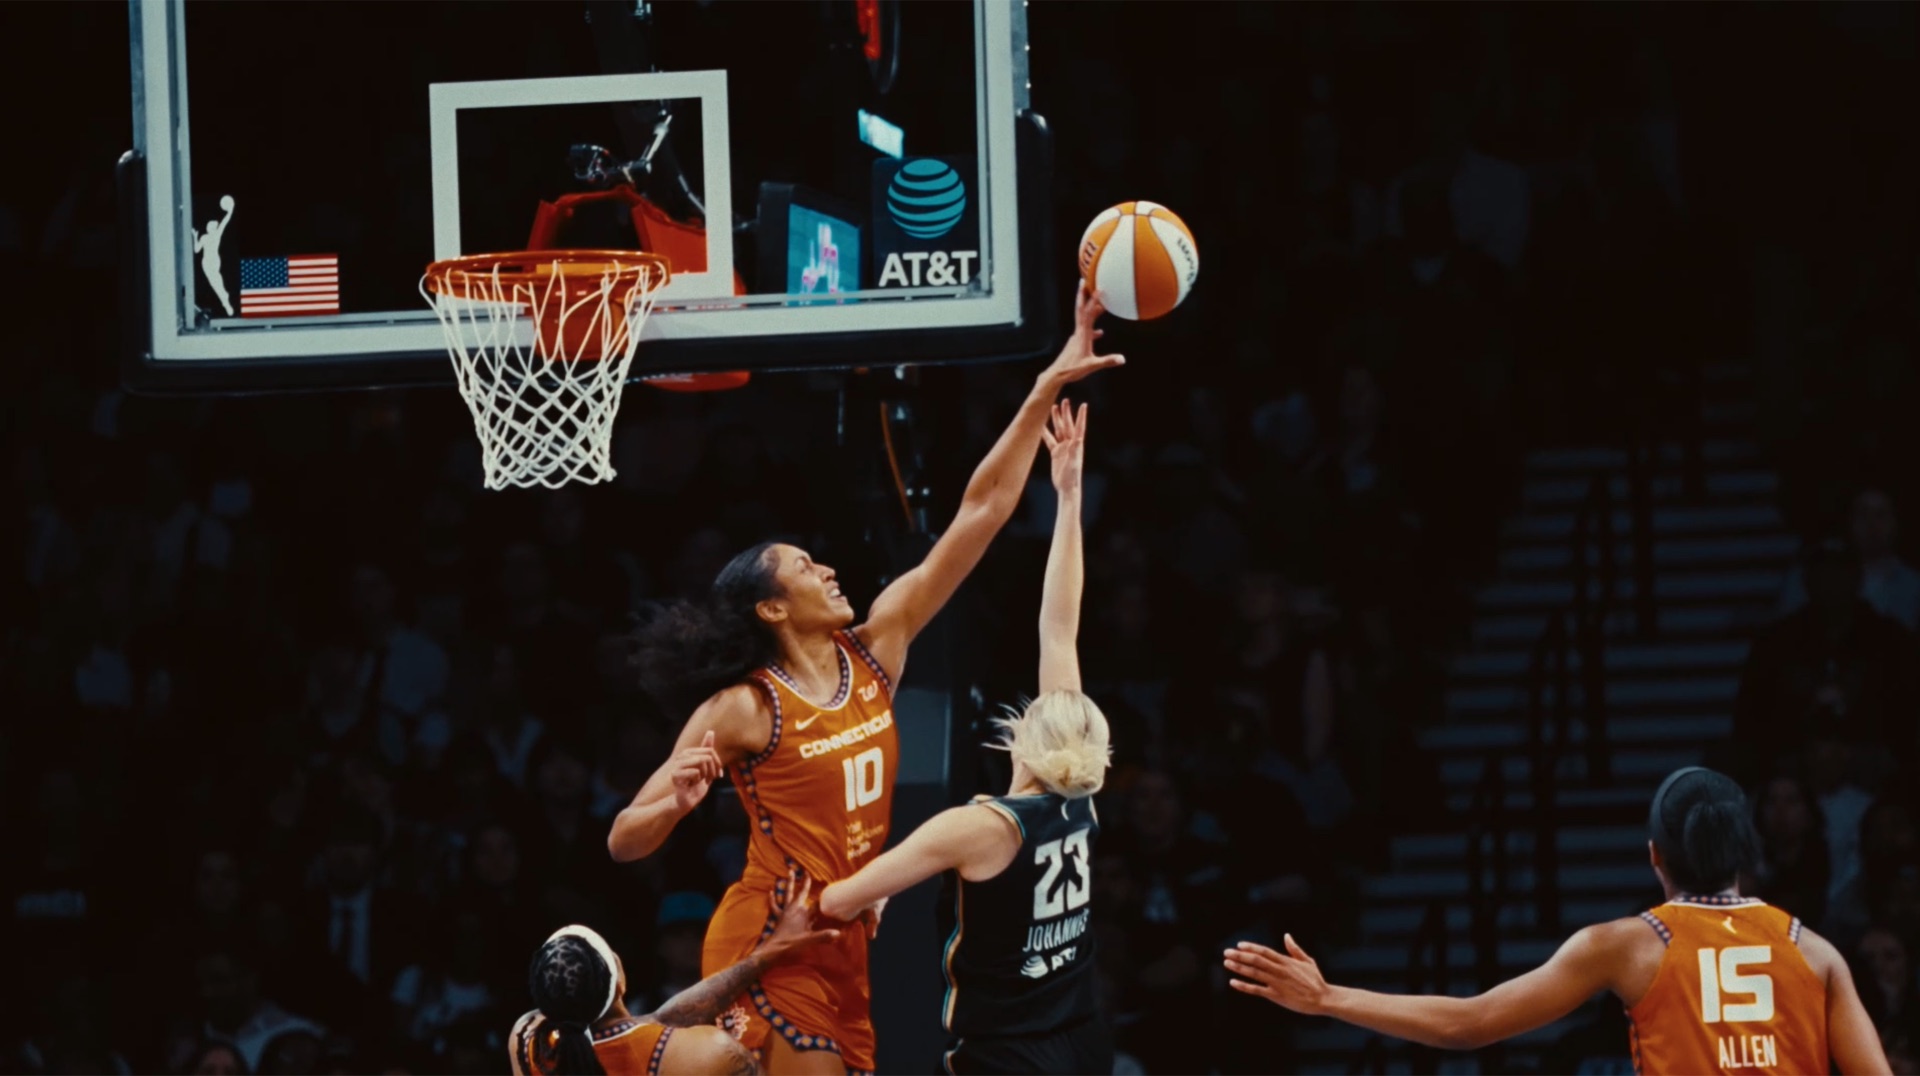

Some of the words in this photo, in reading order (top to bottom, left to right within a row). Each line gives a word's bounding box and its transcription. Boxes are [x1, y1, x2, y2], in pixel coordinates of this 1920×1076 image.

[878, 250, 978, 287] AT&T
[799, 709, 893, 759] CONNECTICU
[842, 746, 884, 812] 10
[1033, 828, 1090, 920] 23
[1698, 945, 1774, 1024] 15
[1718, 1034, 1778, 1069] ALLEN
